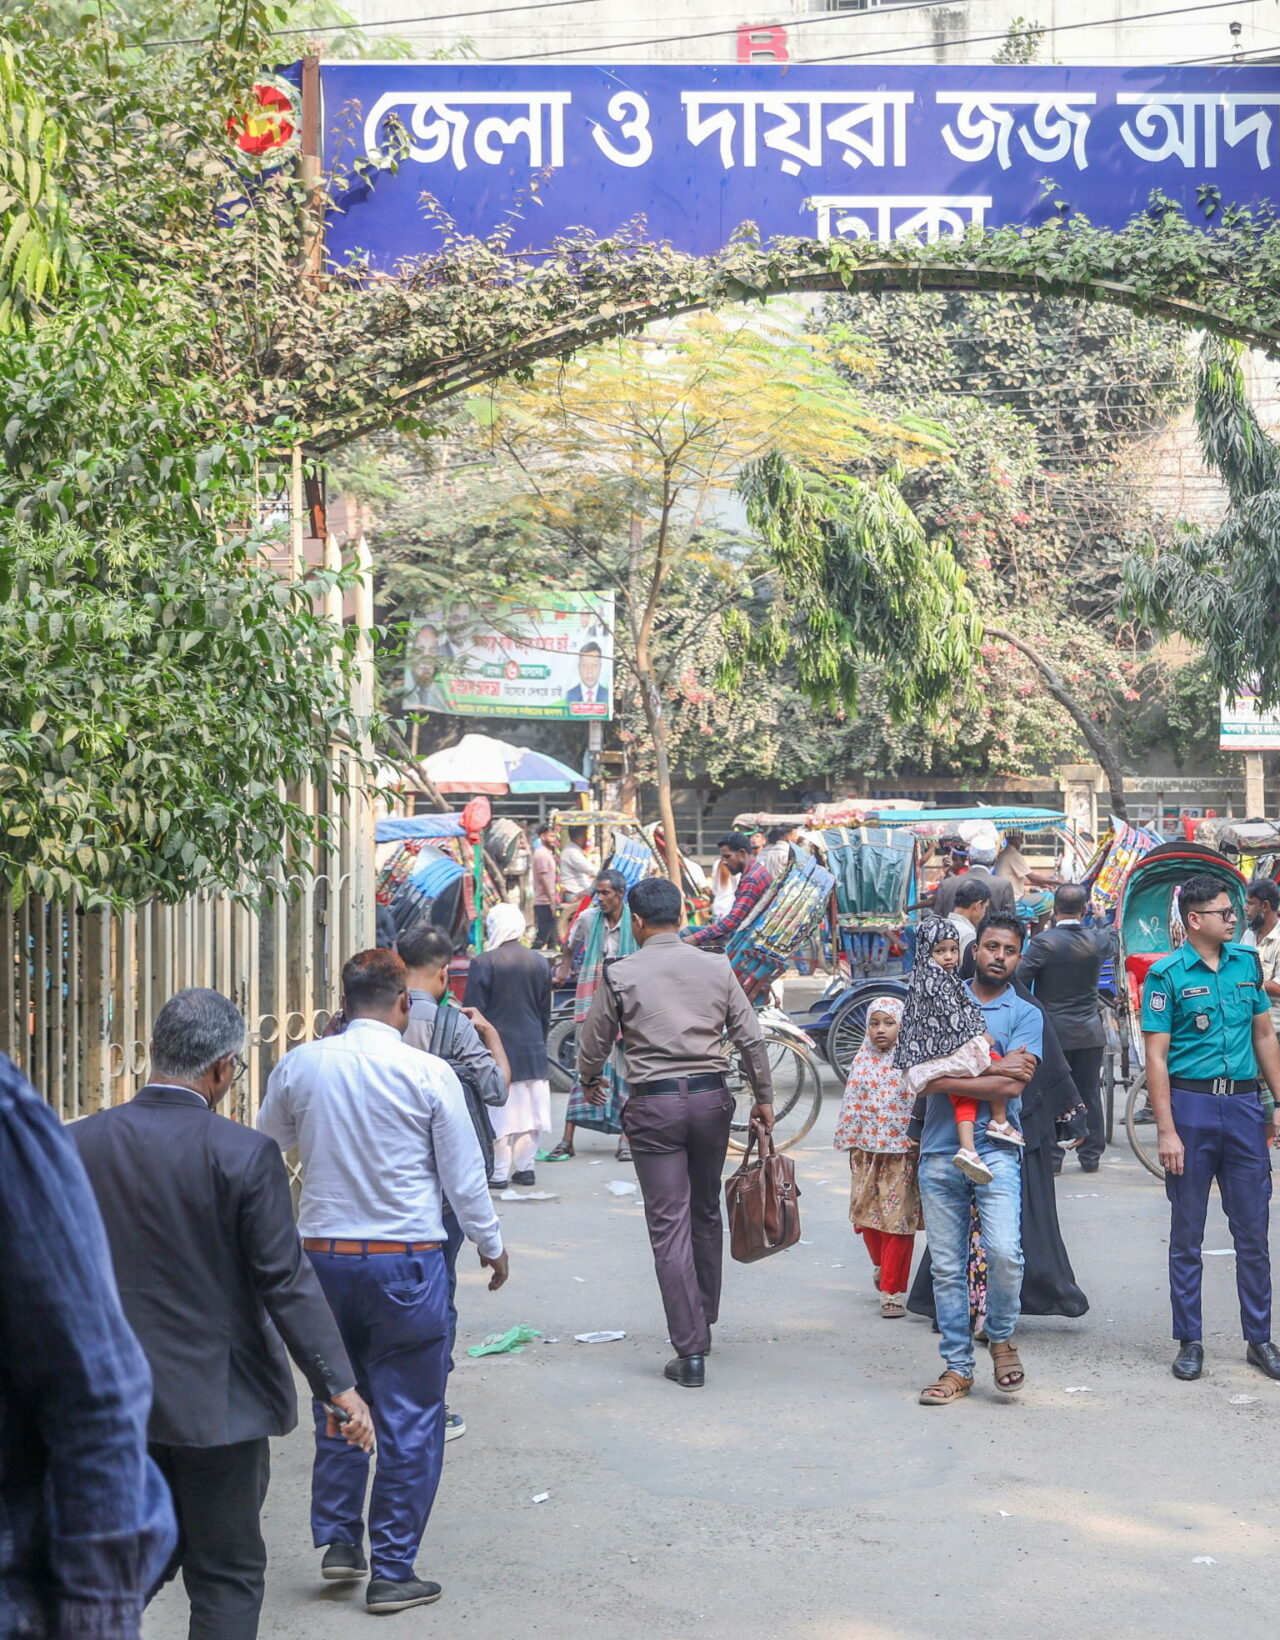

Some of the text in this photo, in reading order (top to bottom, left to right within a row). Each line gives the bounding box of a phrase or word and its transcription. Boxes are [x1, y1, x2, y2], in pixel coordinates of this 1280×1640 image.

[364, 91, 572, 171] জেলা
[592, 91, 653, 168] ও
[681, 91, 914, 175] দায়রা
[936, 91, 1096, 170] জজ
